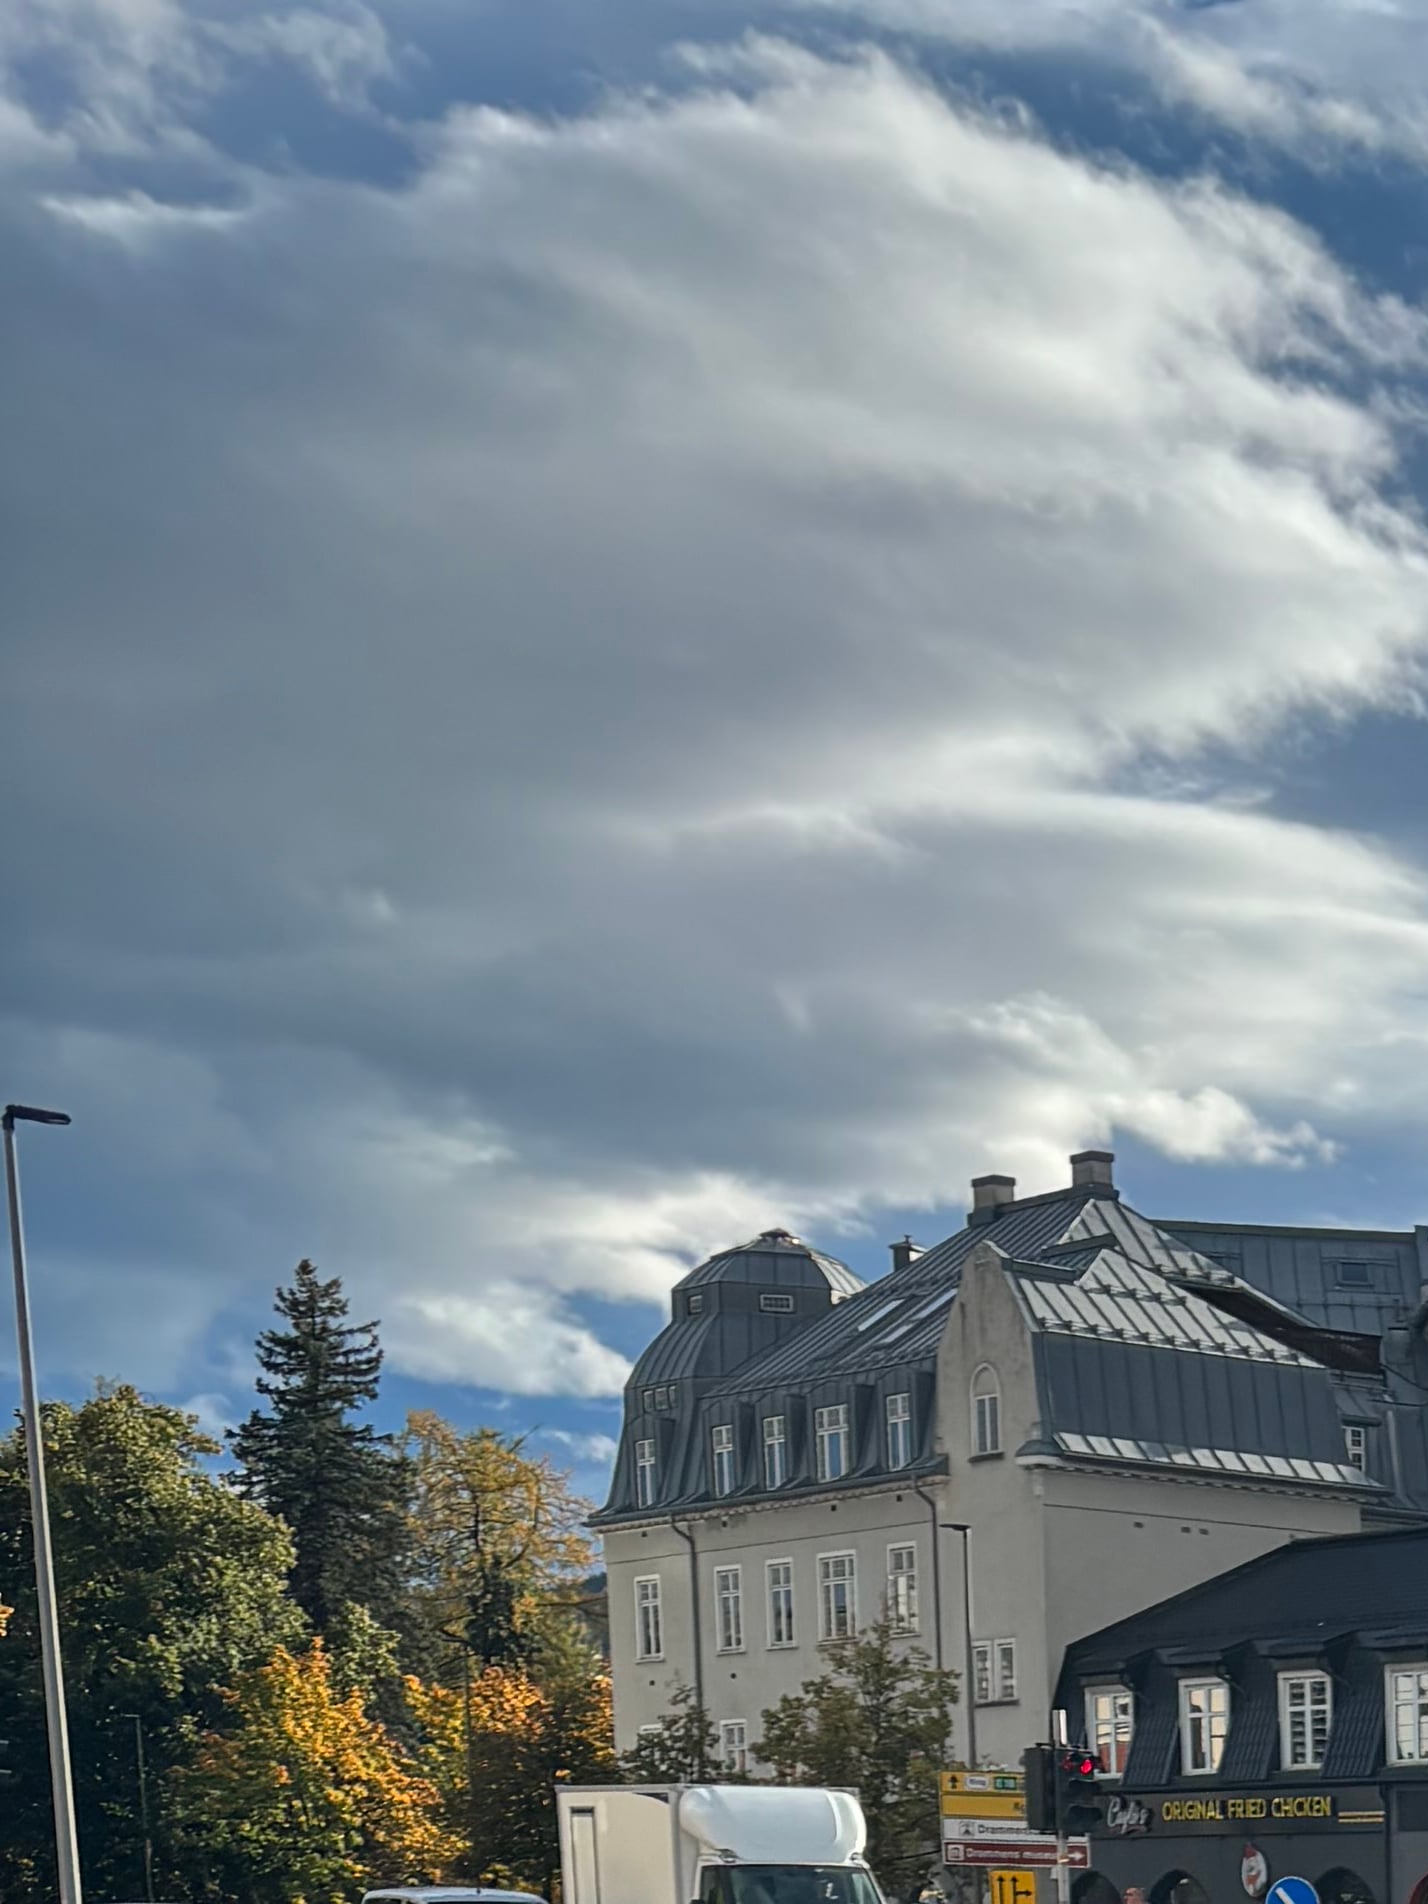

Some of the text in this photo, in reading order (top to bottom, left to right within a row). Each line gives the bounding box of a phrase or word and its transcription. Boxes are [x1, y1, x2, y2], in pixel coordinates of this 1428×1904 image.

[1162, 1796, 1331, 1821] ORIGINAL FRIED CHICKEN
